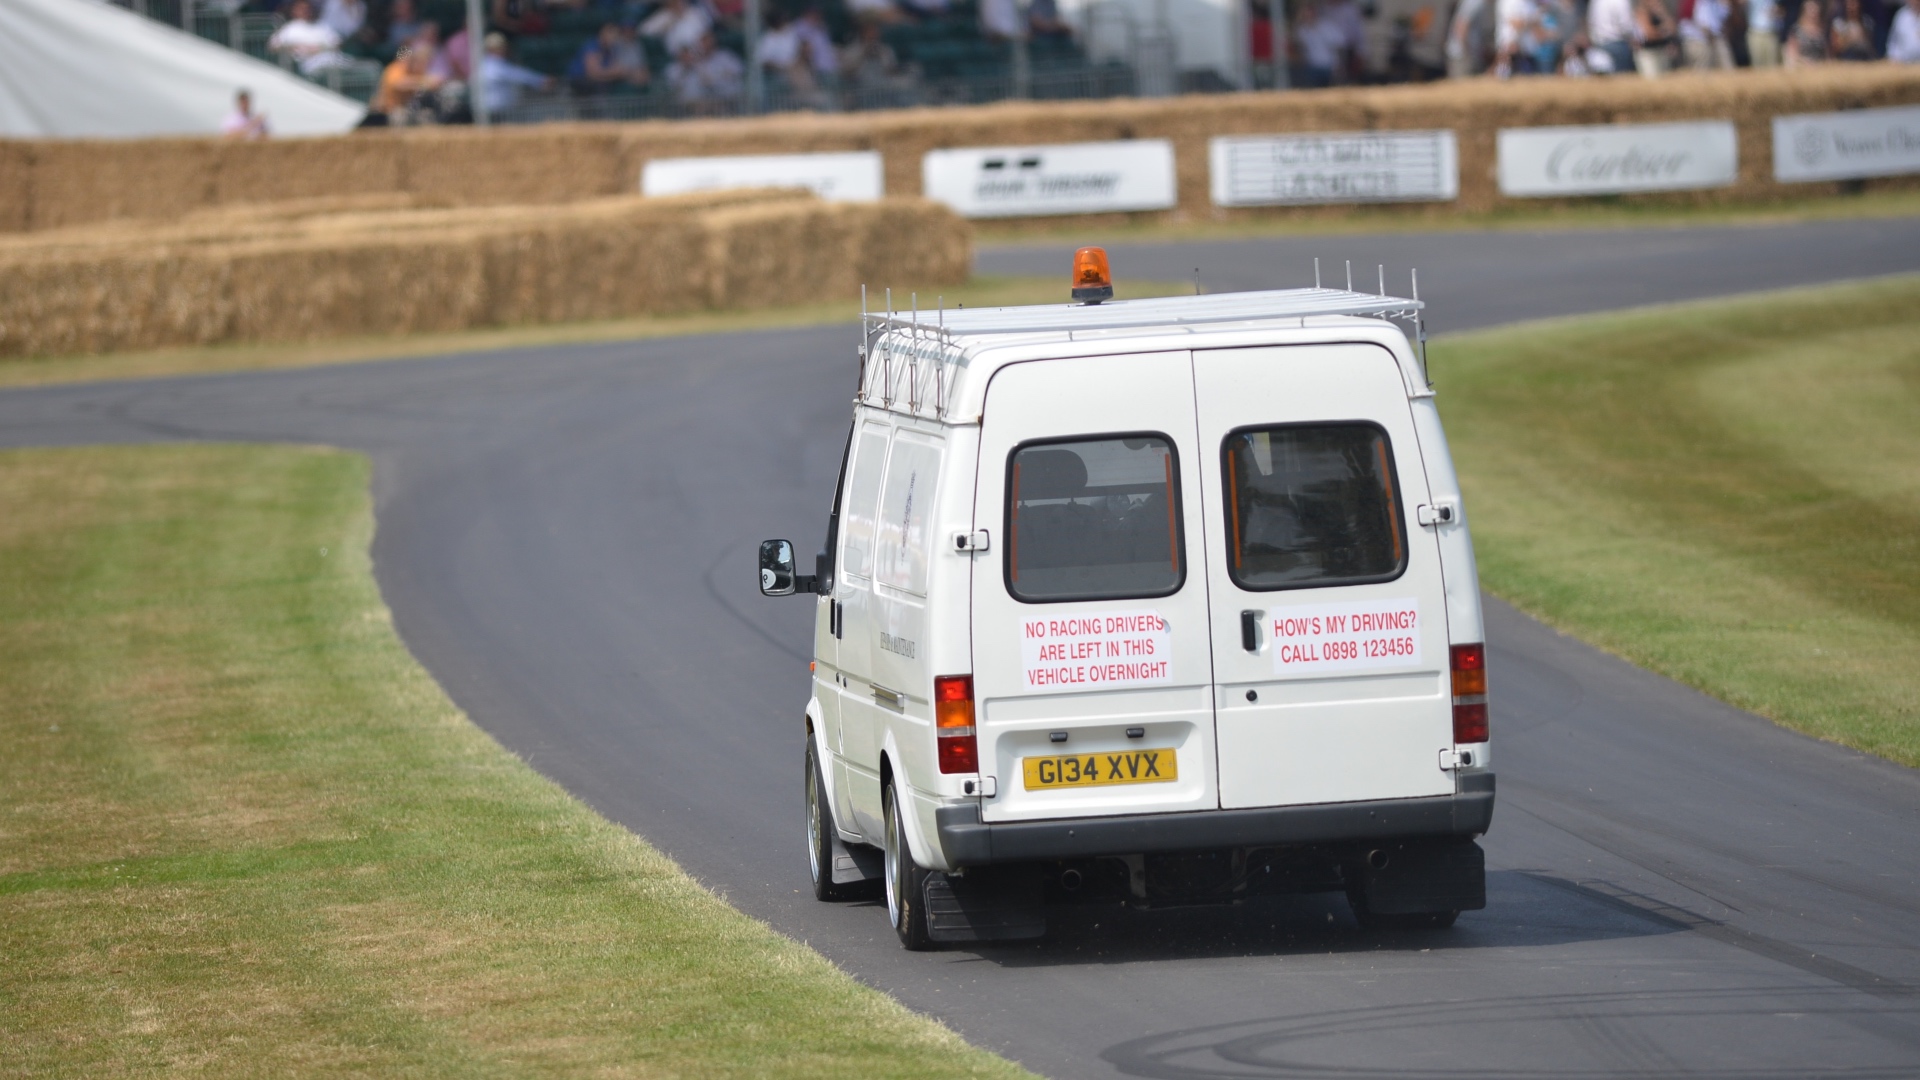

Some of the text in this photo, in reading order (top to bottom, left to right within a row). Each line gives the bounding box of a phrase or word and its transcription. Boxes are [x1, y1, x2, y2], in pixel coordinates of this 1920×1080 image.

[1025, 615, 1164, 638] NO RACING DRIVERS
[1274, 610, 1417, 637] HOW'S MY DRIVING?
[1039, 638, 1155, 661] ARE LEFT IN THIS
[1281, 636, 1414, 663] CALL 0898 123456
[1028, 661, 1168, 685] VEHICLE OVERNIGHT
[1038, 752, 1160, 784] G134 XVX
